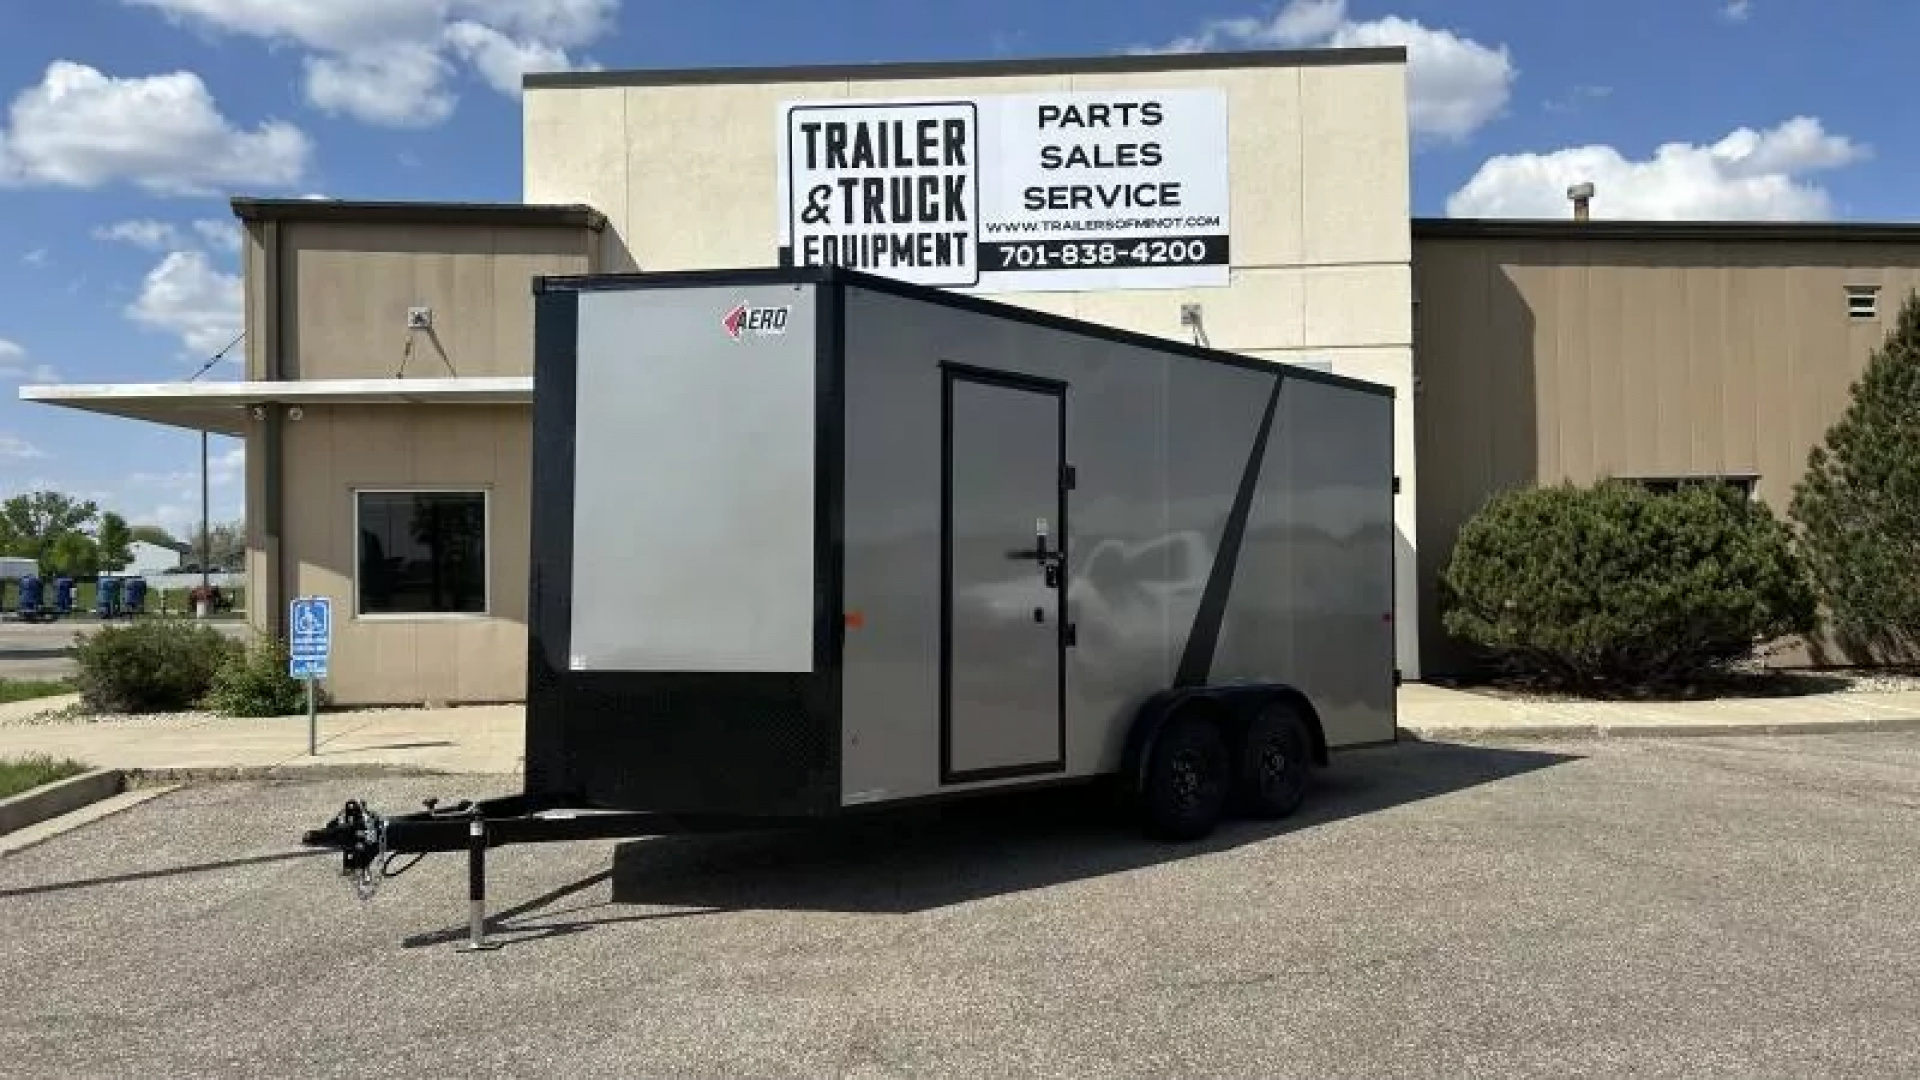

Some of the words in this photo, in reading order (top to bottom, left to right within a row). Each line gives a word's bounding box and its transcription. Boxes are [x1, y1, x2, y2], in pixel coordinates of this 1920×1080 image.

[1038, 102, 1163, 129] PARTS
[801, 119, 967, 170] TRAILER
[1040, 143, 1163, 169] SALES
[801, 184, 833, 225] &
[837, 174, 967, 224] TRUCK
[1024, 182, 1181, 211] SERVICE
[986, 215, 1220, 233] WWW.TRAILERSOFMINOT.COM
[803, 232, 968, 268] EQUIPMENT
[999, 240, 1206, 267] 701-838-4200
[737, 308, 788, 330] AERO
